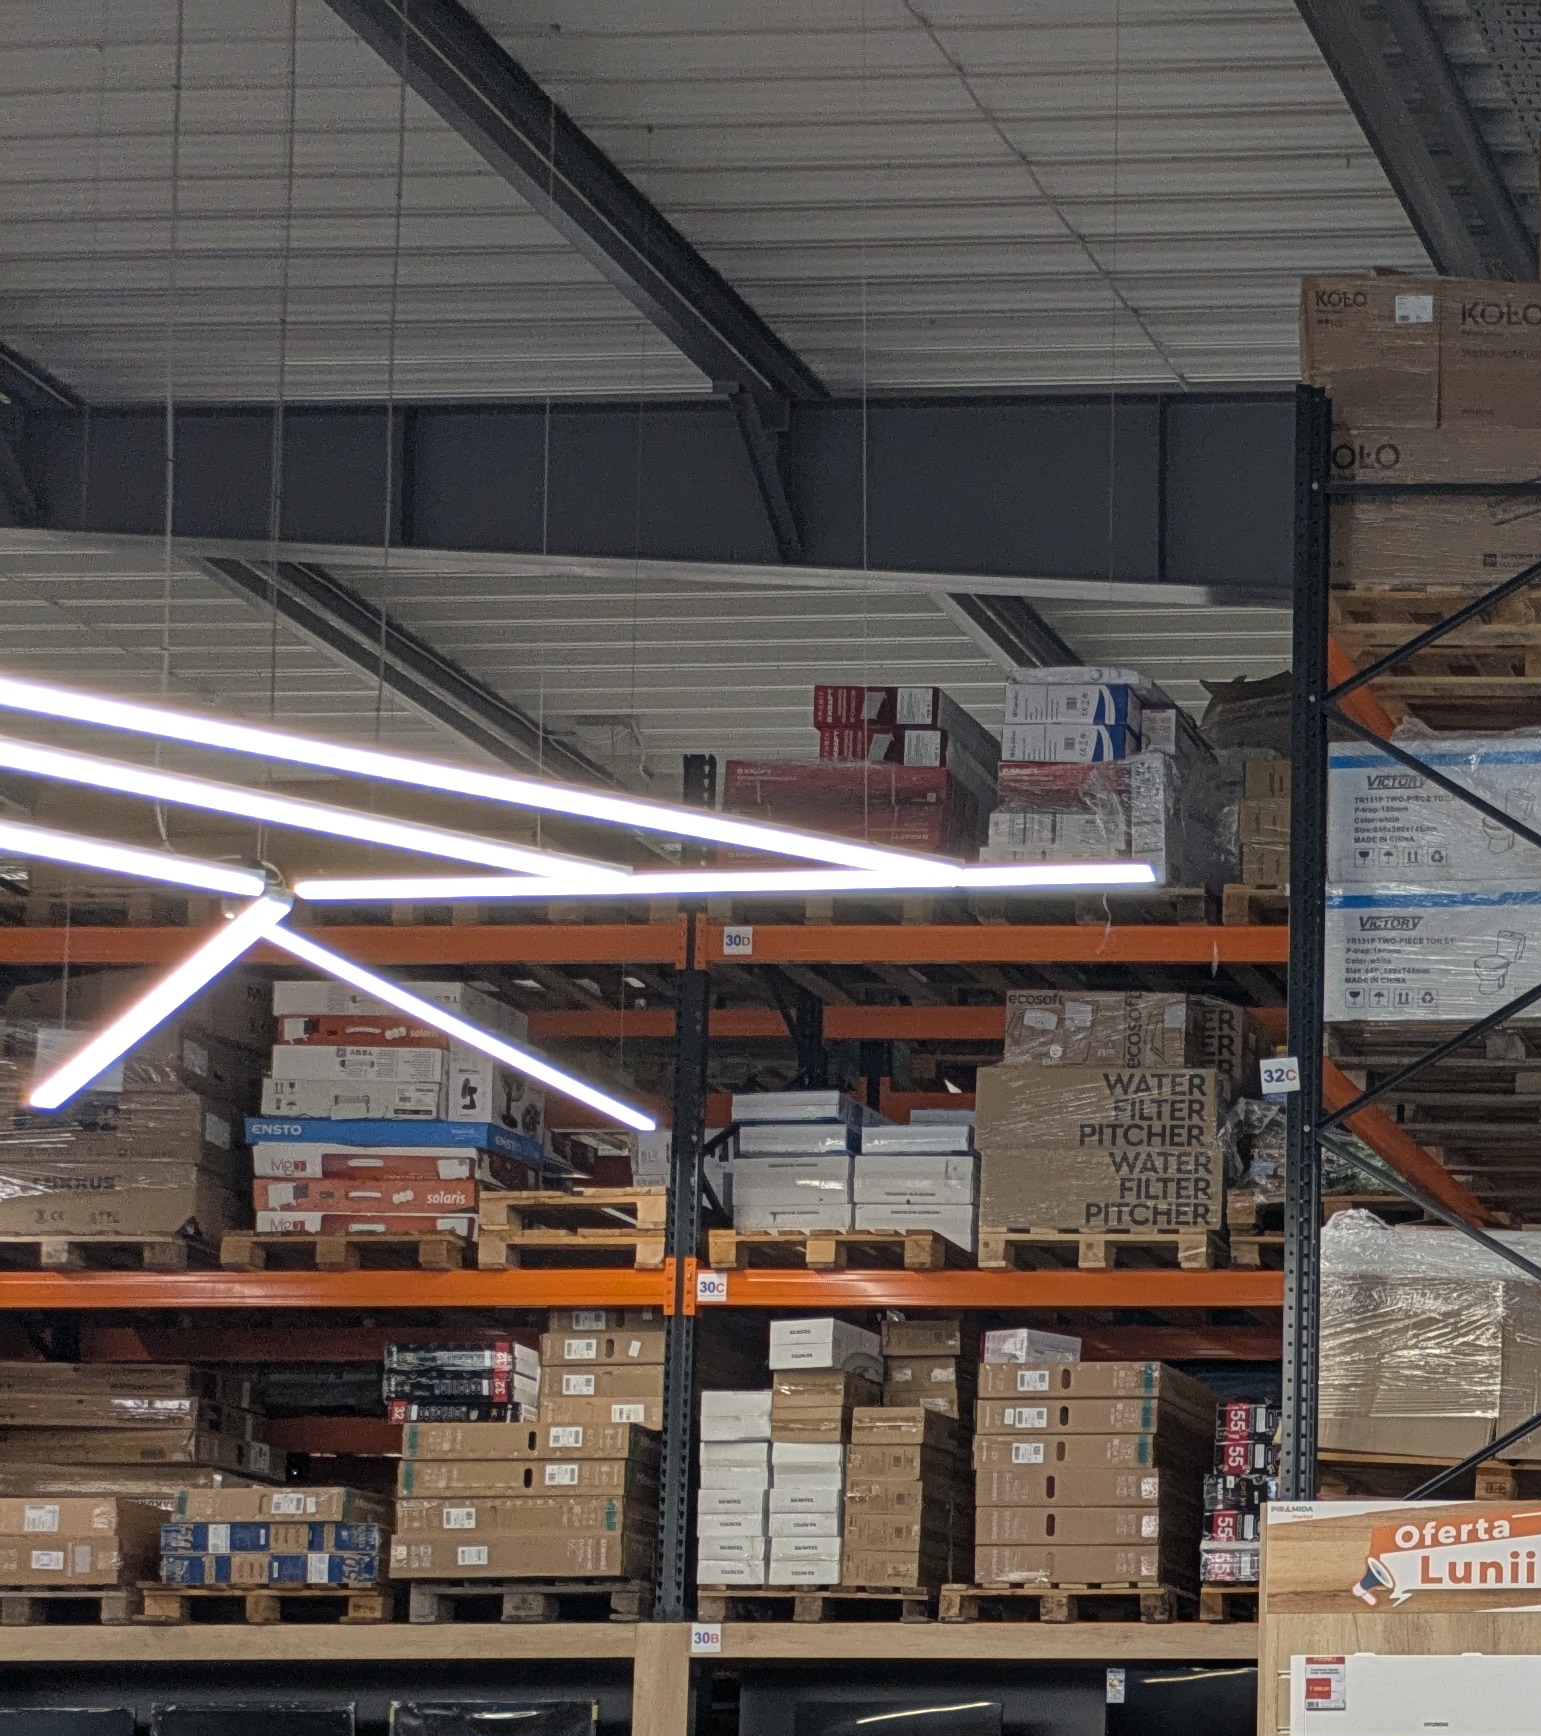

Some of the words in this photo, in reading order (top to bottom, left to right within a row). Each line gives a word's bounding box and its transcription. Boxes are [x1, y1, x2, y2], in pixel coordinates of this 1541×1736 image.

[1314, 289, 1368, 308] KOŁO
[1331, 443, 1401, 472] OŁO
[1359, 916, 1424, 931] VICTORY
[725, 934, 751, 948] 30D
[1007, 992, 1064, 1008] ecosoft
[1102, 1073, 1208, 1097] WATER
[1262, 1068, 1298, 1085] 32C
[1113, 1098, 1207, 1121] FILTER
[251, 1124, 303, 1136] ENSTO
[1080, 1123, 1206, 1147] PITCHER
[1108, 1151, 1211, 1175] WATER
[427, 1190, 467, 1205] solaris
[1118, 1178, 1211, 1200] FILTER
[1083, 1203, 1211, 1225] PITCHER
[699, 1281, 726, 1294] 30C
[1228, 1444, 1245, 1469] 55
[1394, 1517, 1511, 1551] Oferta
[1419, 1550, 1536, 1586] Lunii
[693, 1631, 721, 1645] 30B
